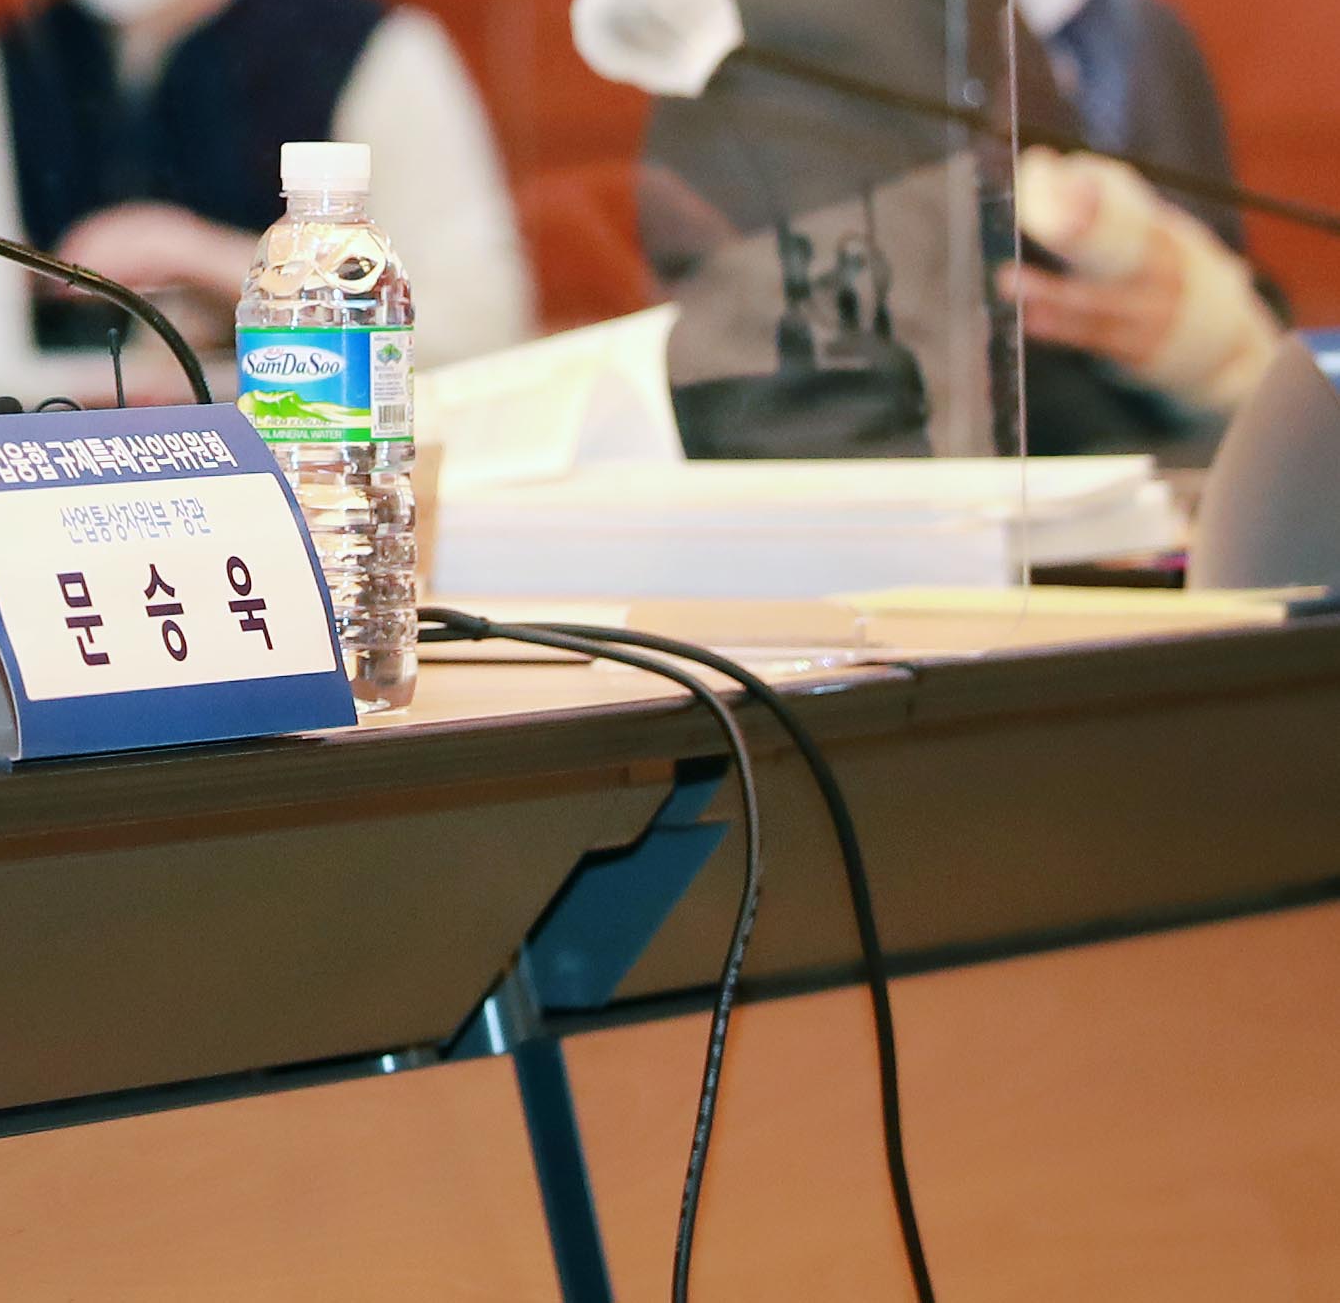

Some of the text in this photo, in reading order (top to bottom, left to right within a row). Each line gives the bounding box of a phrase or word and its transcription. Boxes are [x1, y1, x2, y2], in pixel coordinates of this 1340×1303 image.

[246, 352, 340, 376] SamDaSoo
[272, 428, 308, 439] MINERAL
[310, 428, 343, 439] WATER
[44, 430, 238, 479] 규제특례심의위원회
[59, 497, 212, 544] 산업통상자원부 장관
